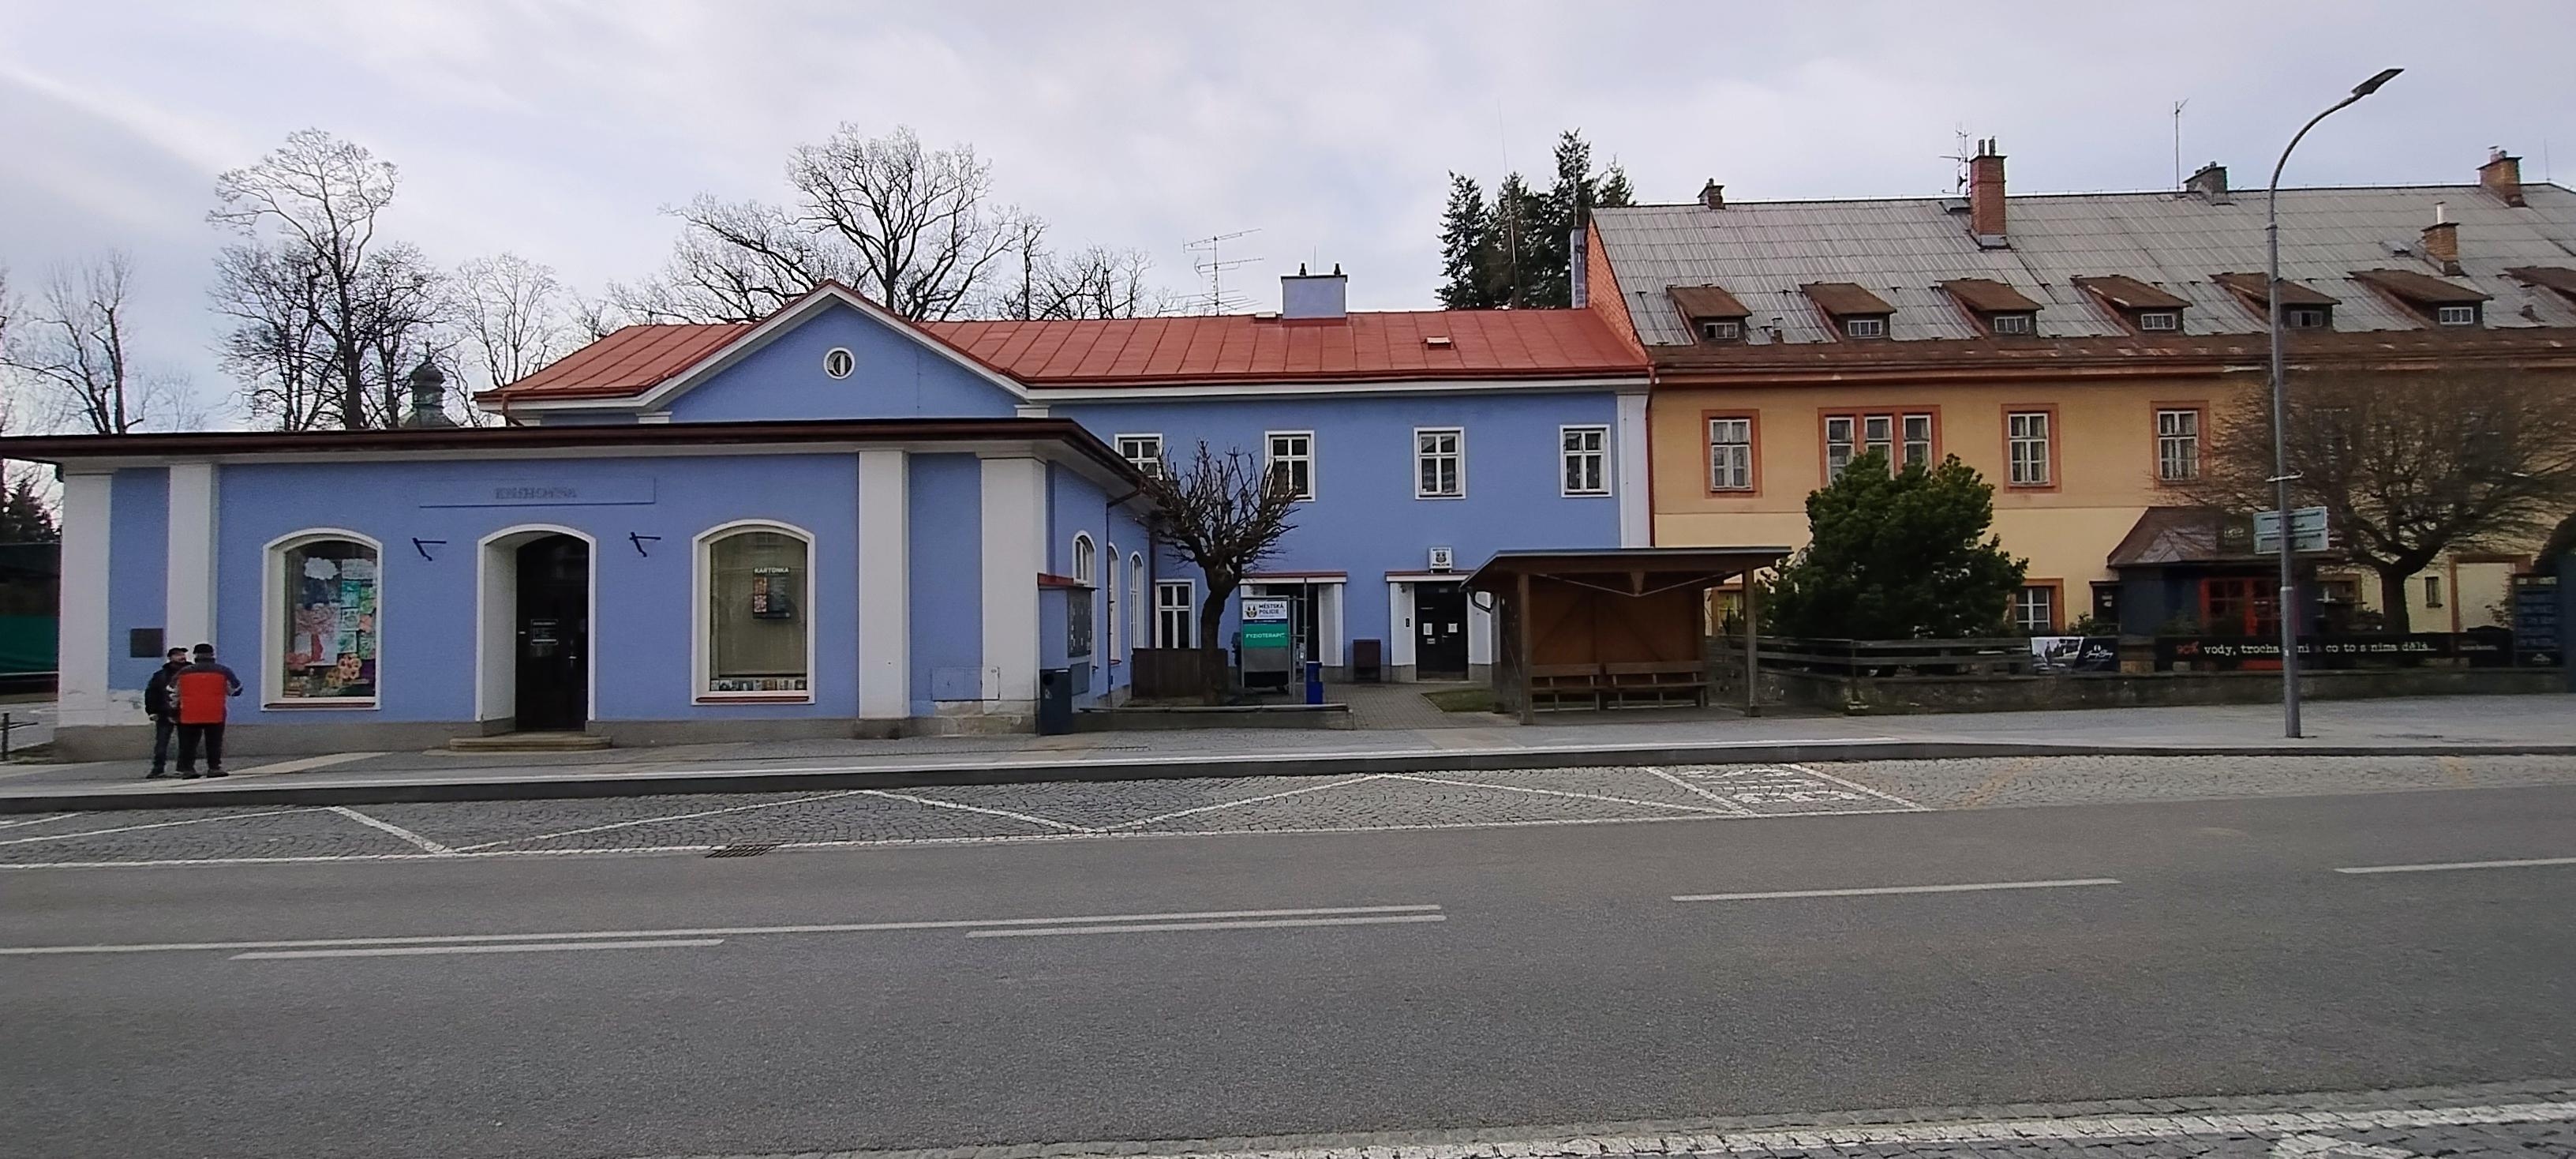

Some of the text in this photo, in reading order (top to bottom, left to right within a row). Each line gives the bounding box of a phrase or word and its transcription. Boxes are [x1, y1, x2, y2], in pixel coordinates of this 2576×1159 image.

[2203, 644, 2237, 656] vody,
[2240, 644, 2279, 655] trocha
[2343, 643, 2356, 652] to
